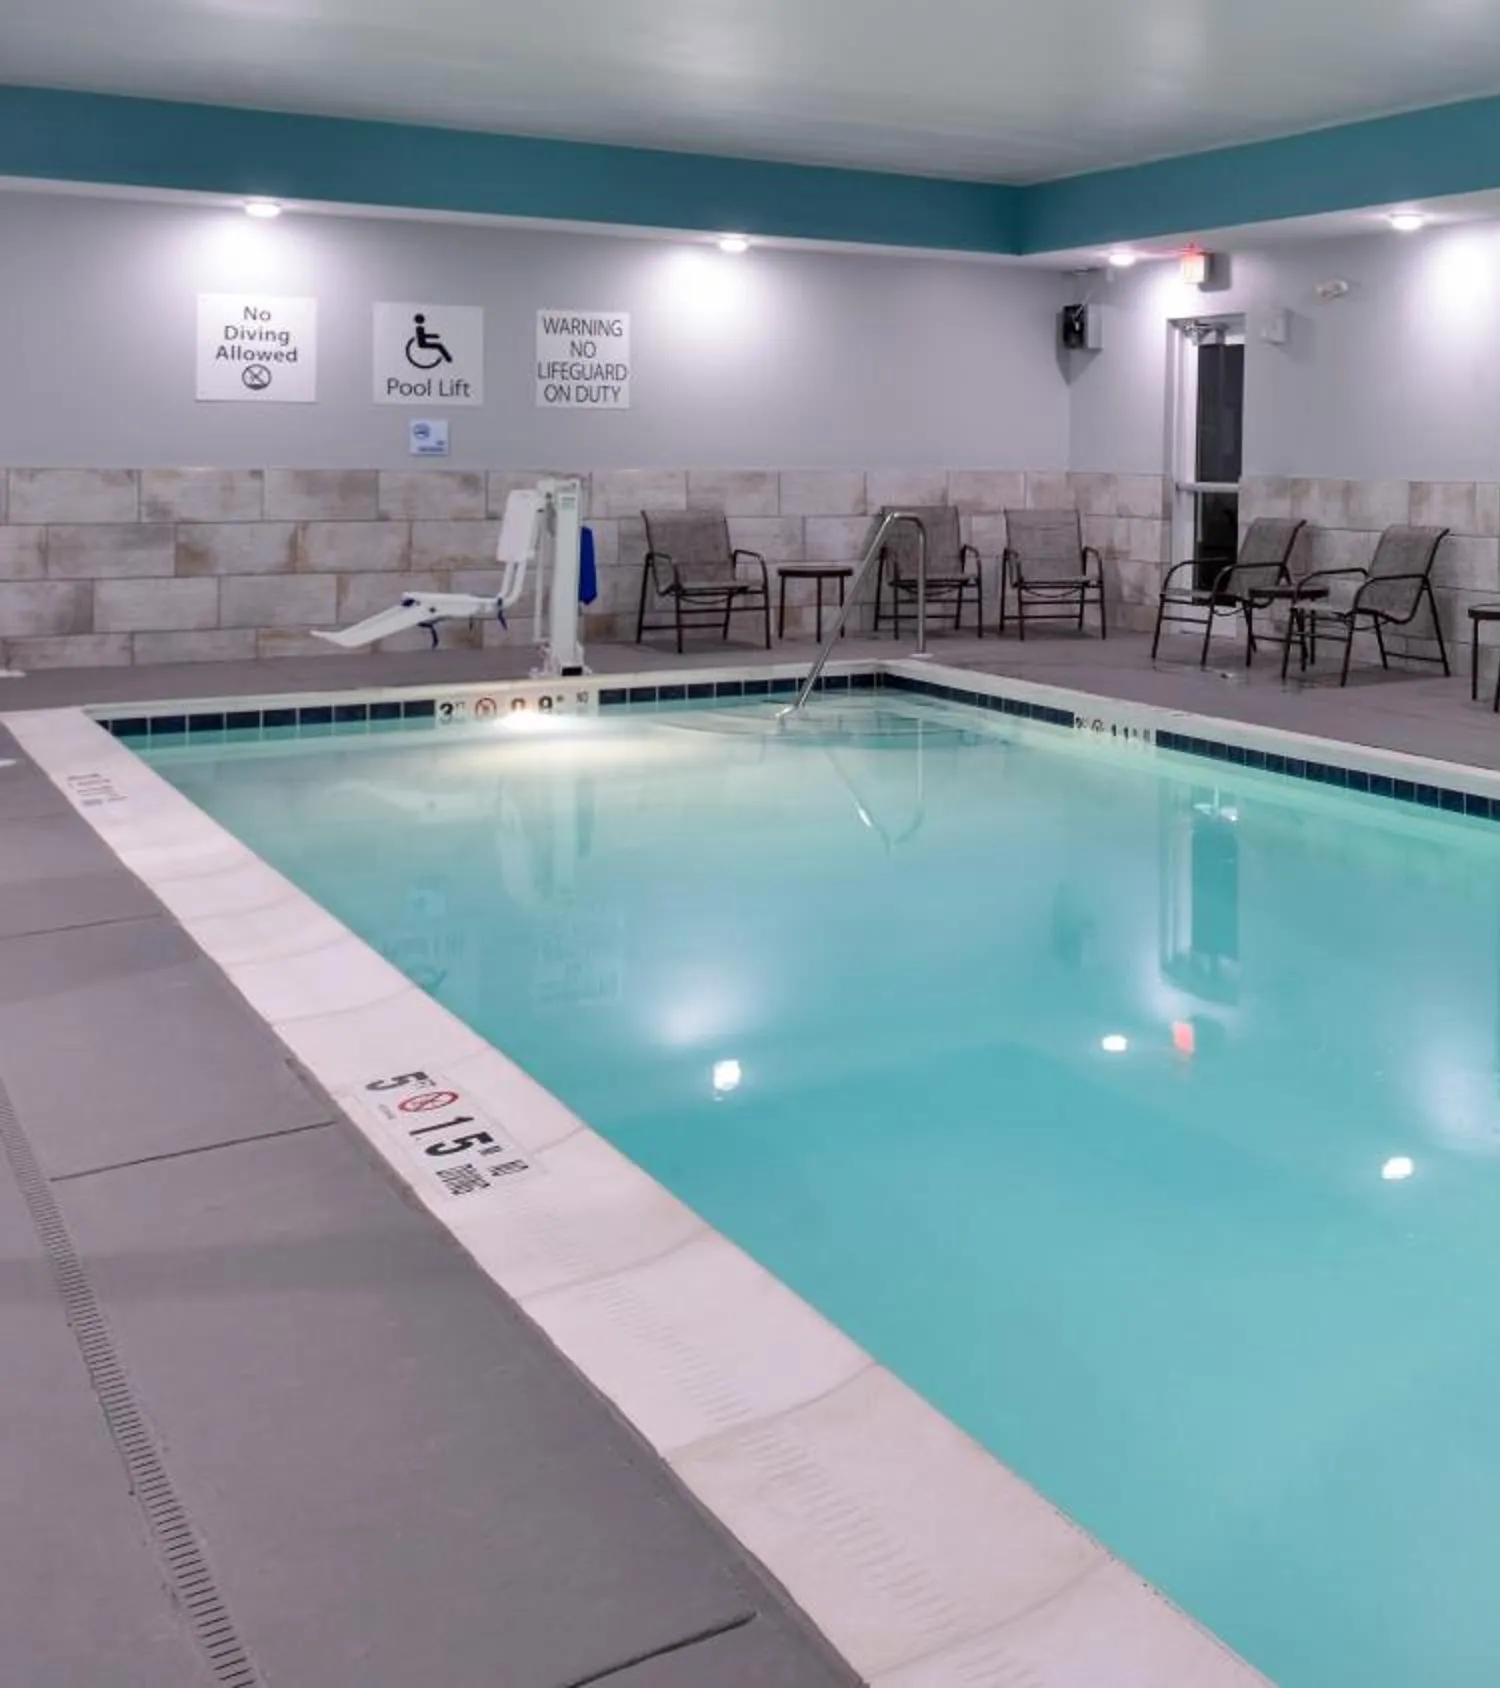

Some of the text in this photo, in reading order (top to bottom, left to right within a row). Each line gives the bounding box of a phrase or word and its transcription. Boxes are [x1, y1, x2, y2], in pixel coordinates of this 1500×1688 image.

[243, 305, 272, 321] No
[223, 324, 290, 347] Diving
[543, 316, 624, 337] WARNING
[215, 344, 299, 363] Allowed
[570, 340, 597, 359] NO
[537, 361, 628, 381] LIFEGUARD
[387, 377, 470, 398] Pool Lift
[543, 383, 622, 403] ON DUTY
